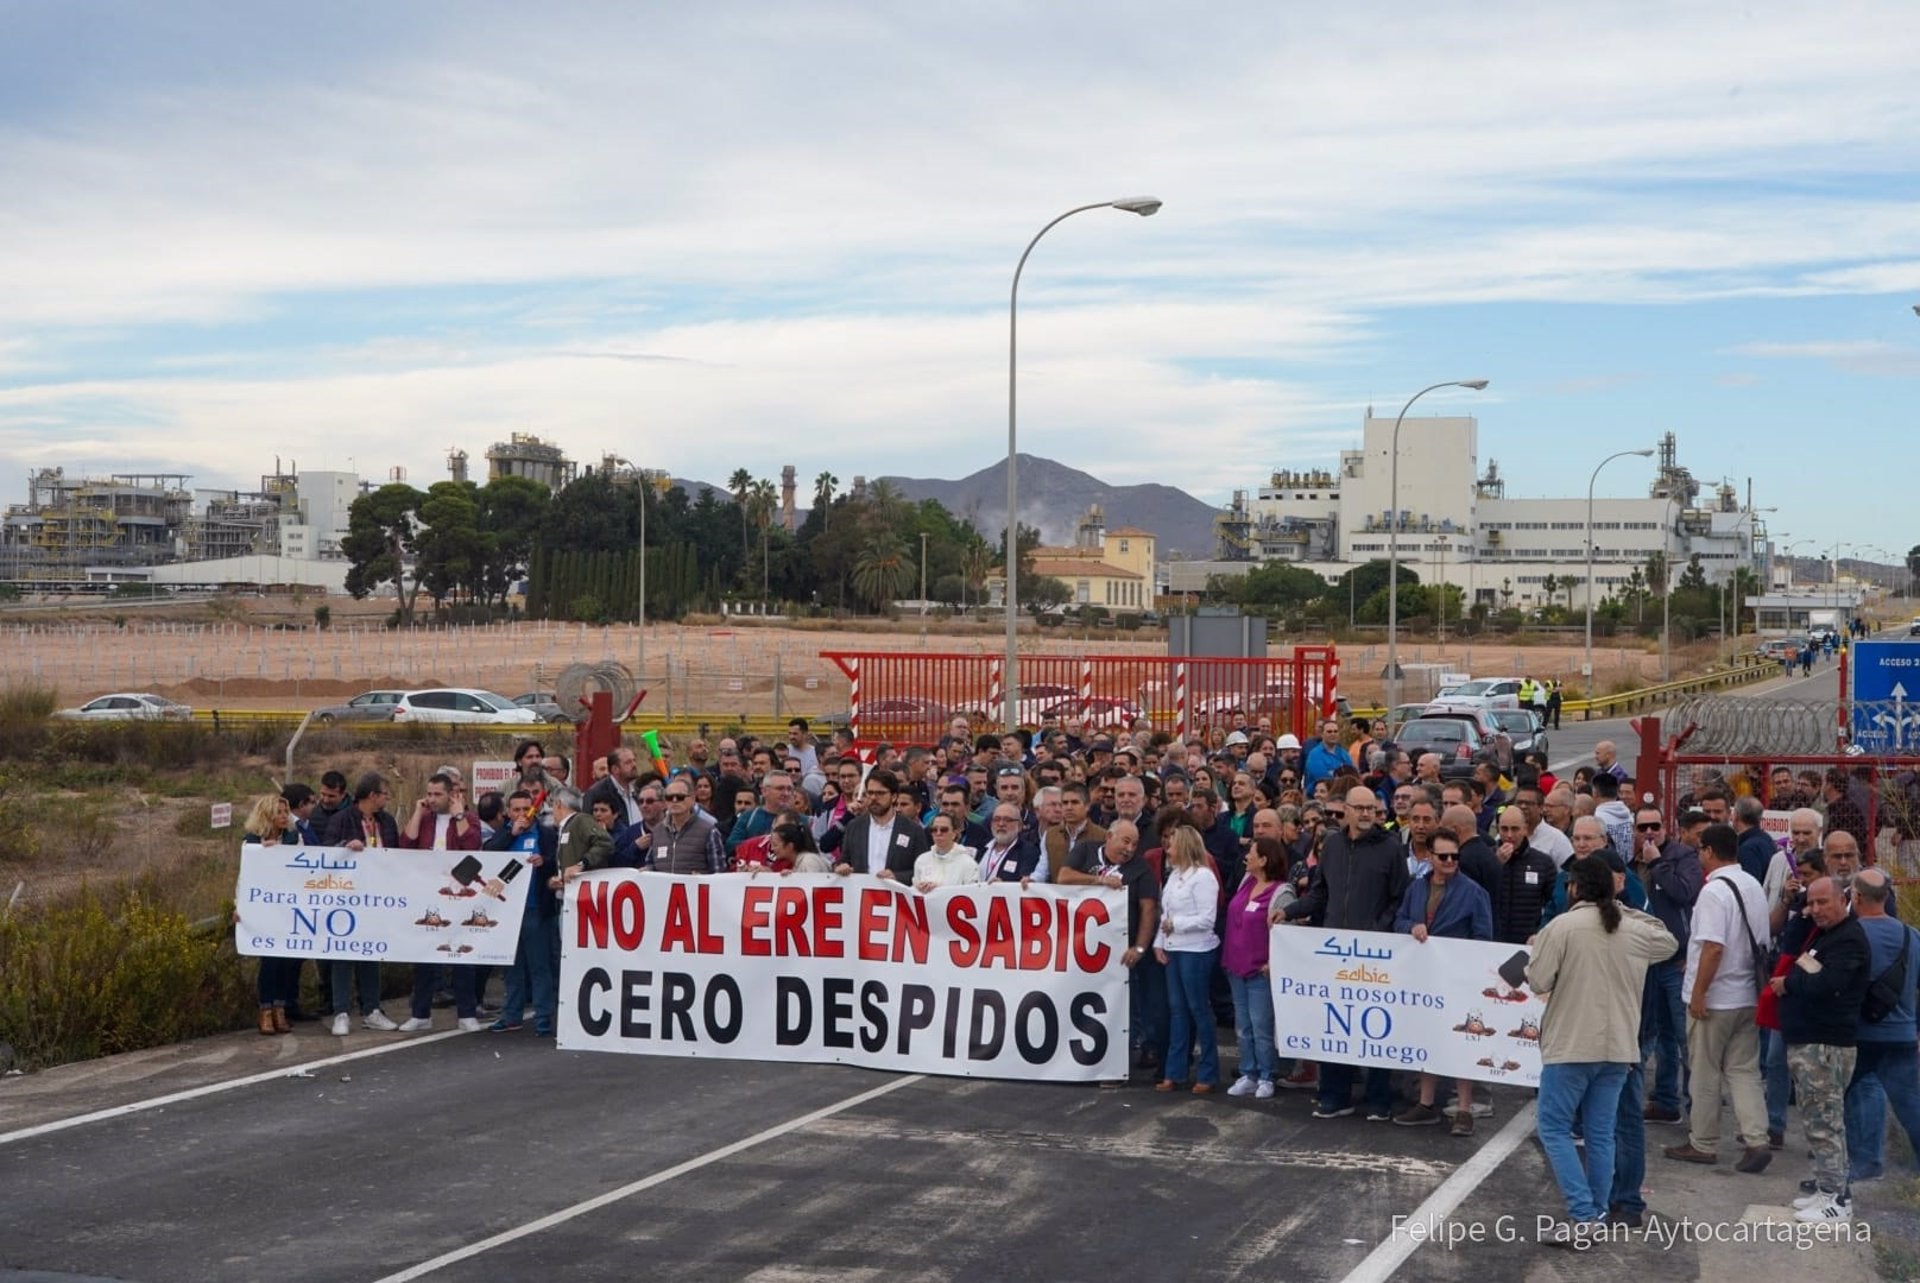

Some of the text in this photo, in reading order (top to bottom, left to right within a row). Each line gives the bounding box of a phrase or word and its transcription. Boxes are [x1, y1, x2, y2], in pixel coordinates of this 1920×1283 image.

[1879, 658, 1911, 667] ACCESO
[249, 888, 408, 909] Para nosotros
[290, 907, 356, 937] NO
[577, 881, 1111, 973] NO AL ERE EN SABIC
[251, 935, 275, 949] es
[286, 938, 313, 950] un
[1280, 977, 1445, 1009] Para nosotros
[578, 967, 1109, 1066] CERO DESPIDOS
[1323, 1002, 1393, 1040] NO
[1286, 1034, 1311, 1049] es
[1321, 1037, 1348, 1054] un
